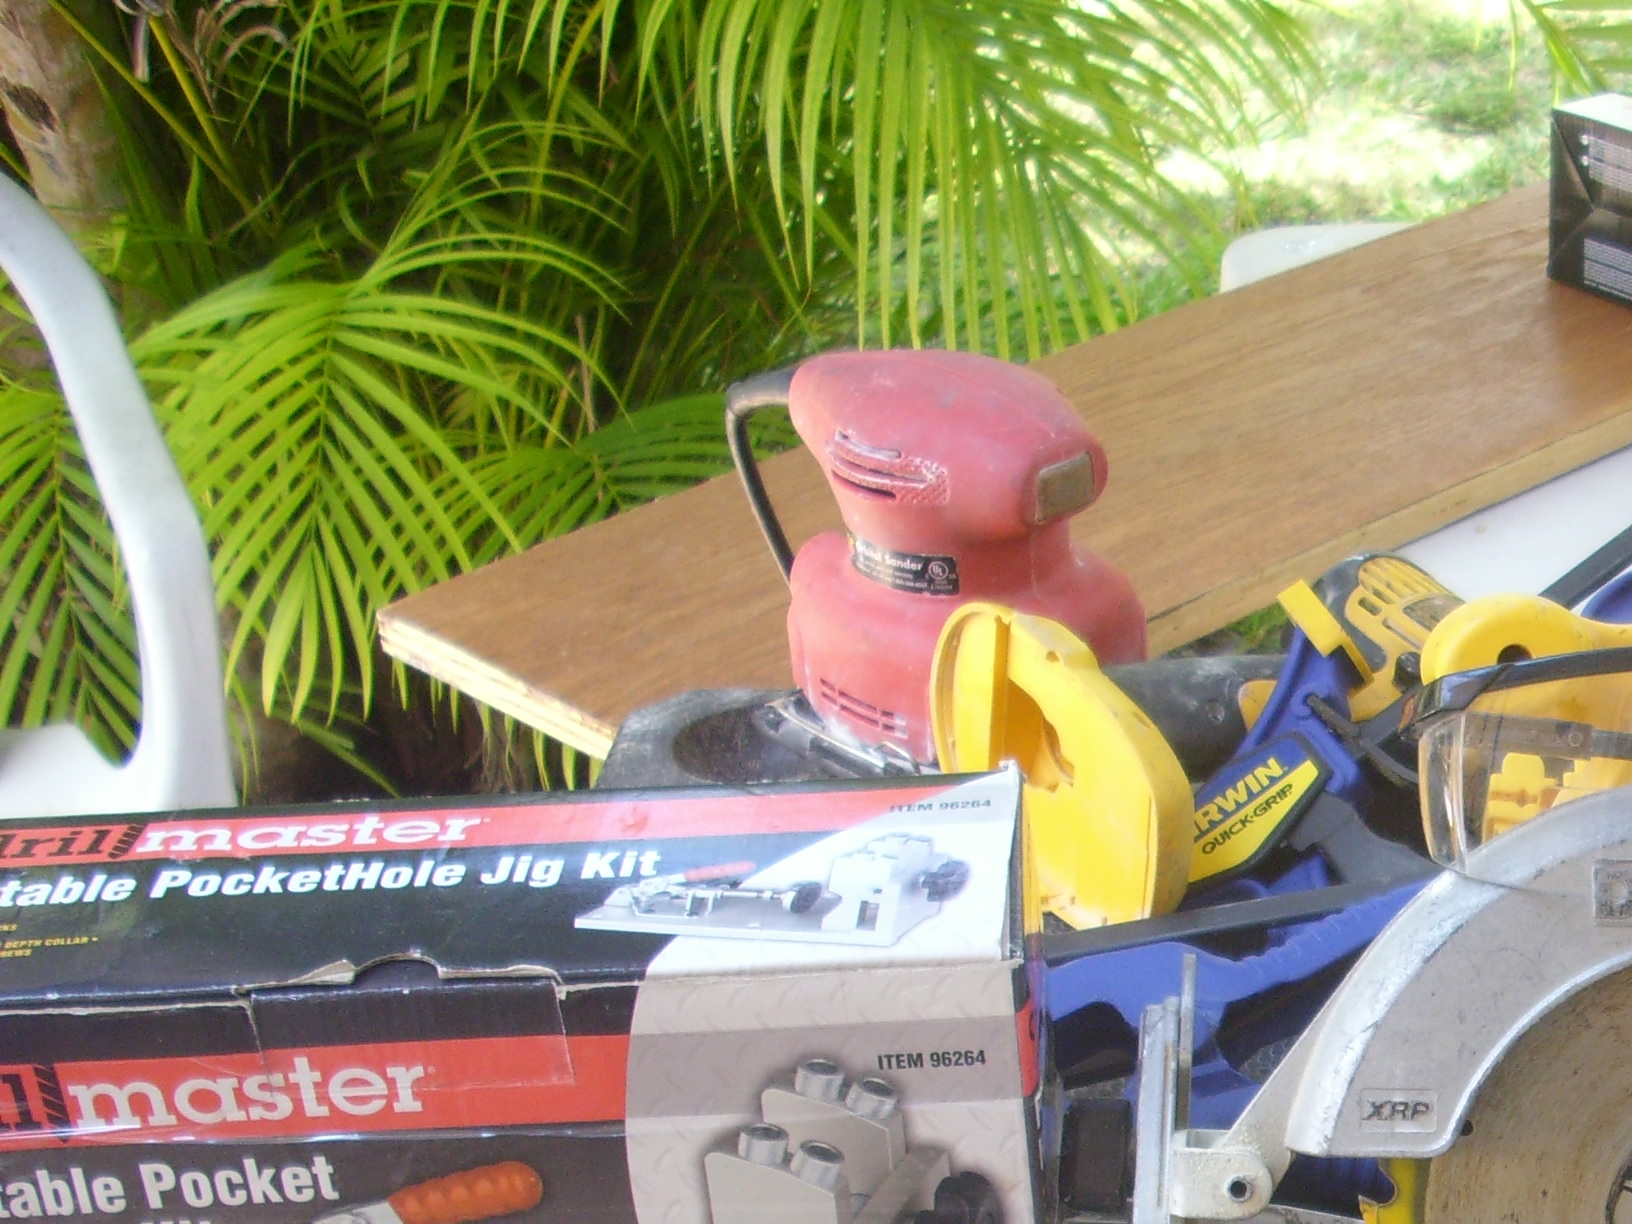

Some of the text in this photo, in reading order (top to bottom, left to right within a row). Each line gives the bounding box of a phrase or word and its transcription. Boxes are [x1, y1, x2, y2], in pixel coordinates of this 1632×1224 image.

[889, 799, 992, 813] ITEM 96264
[1194, 756, 1285, 834] RWIN
[135, 816, 480, 855] master
[0, 849, 662, 907] table PocketHole Jig Kit
[877, 1048, 987, 1071] ITEM 96264
[67, 1055, 426, 1129] master
[1361, 1099, 1430, 1121] XRP
[138, 1154, 341, 1210] Pocket
